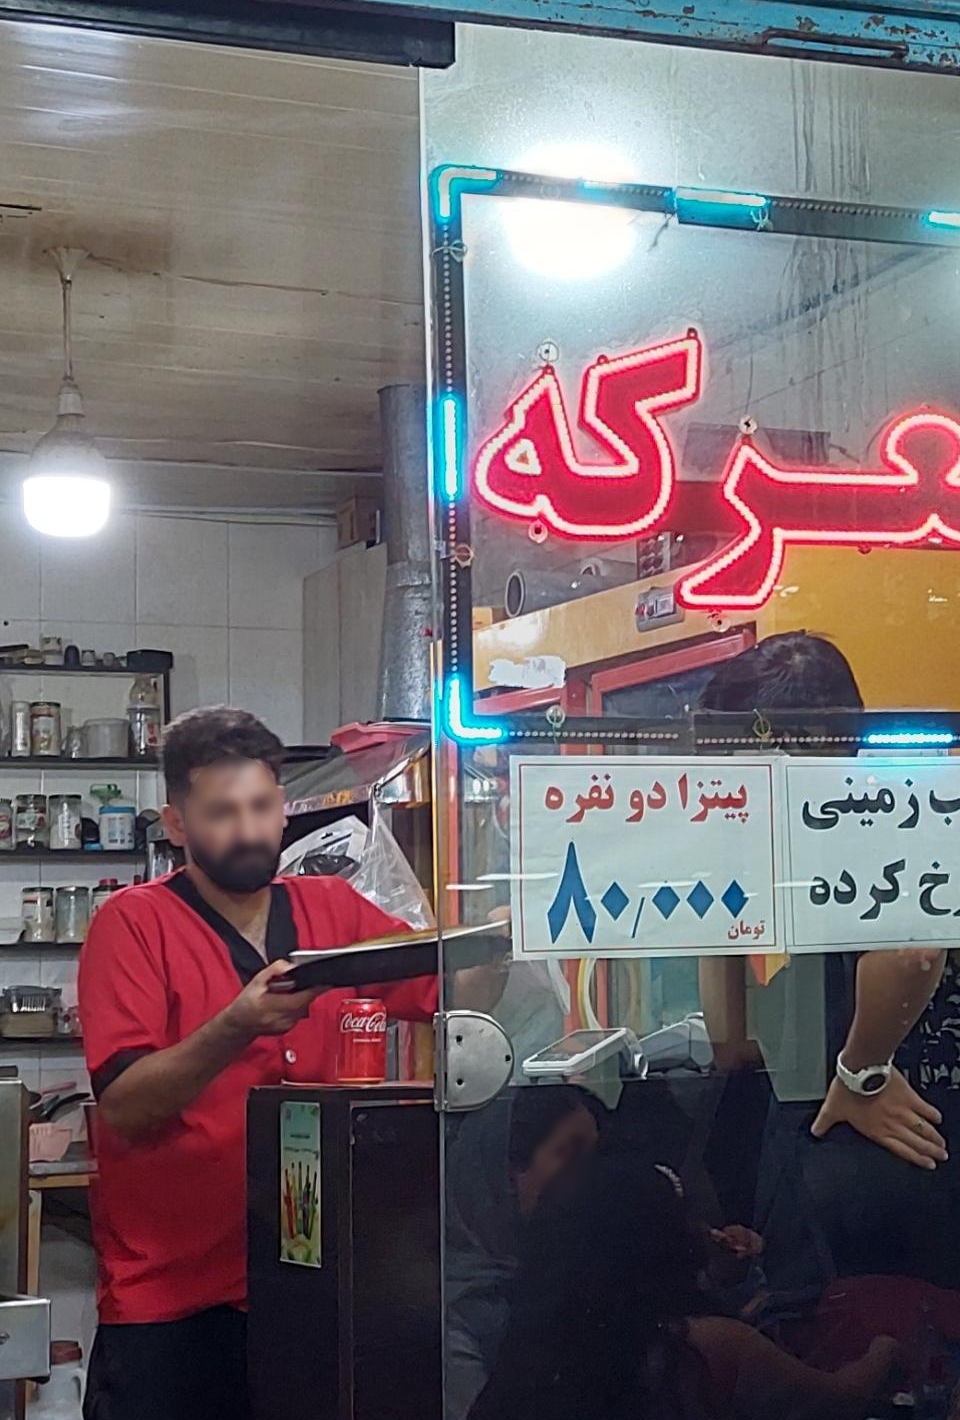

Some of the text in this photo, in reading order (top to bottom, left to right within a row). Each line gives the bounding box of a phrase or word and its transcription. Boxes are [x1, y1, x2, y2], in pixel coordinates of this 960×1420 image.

[545, 773, 750, 824] پیتزا دو نفره
[802, 777, 921, 830] زمینی
[809, 858, 906, 920] کرده
[727, 920, 766, 940] تومان
